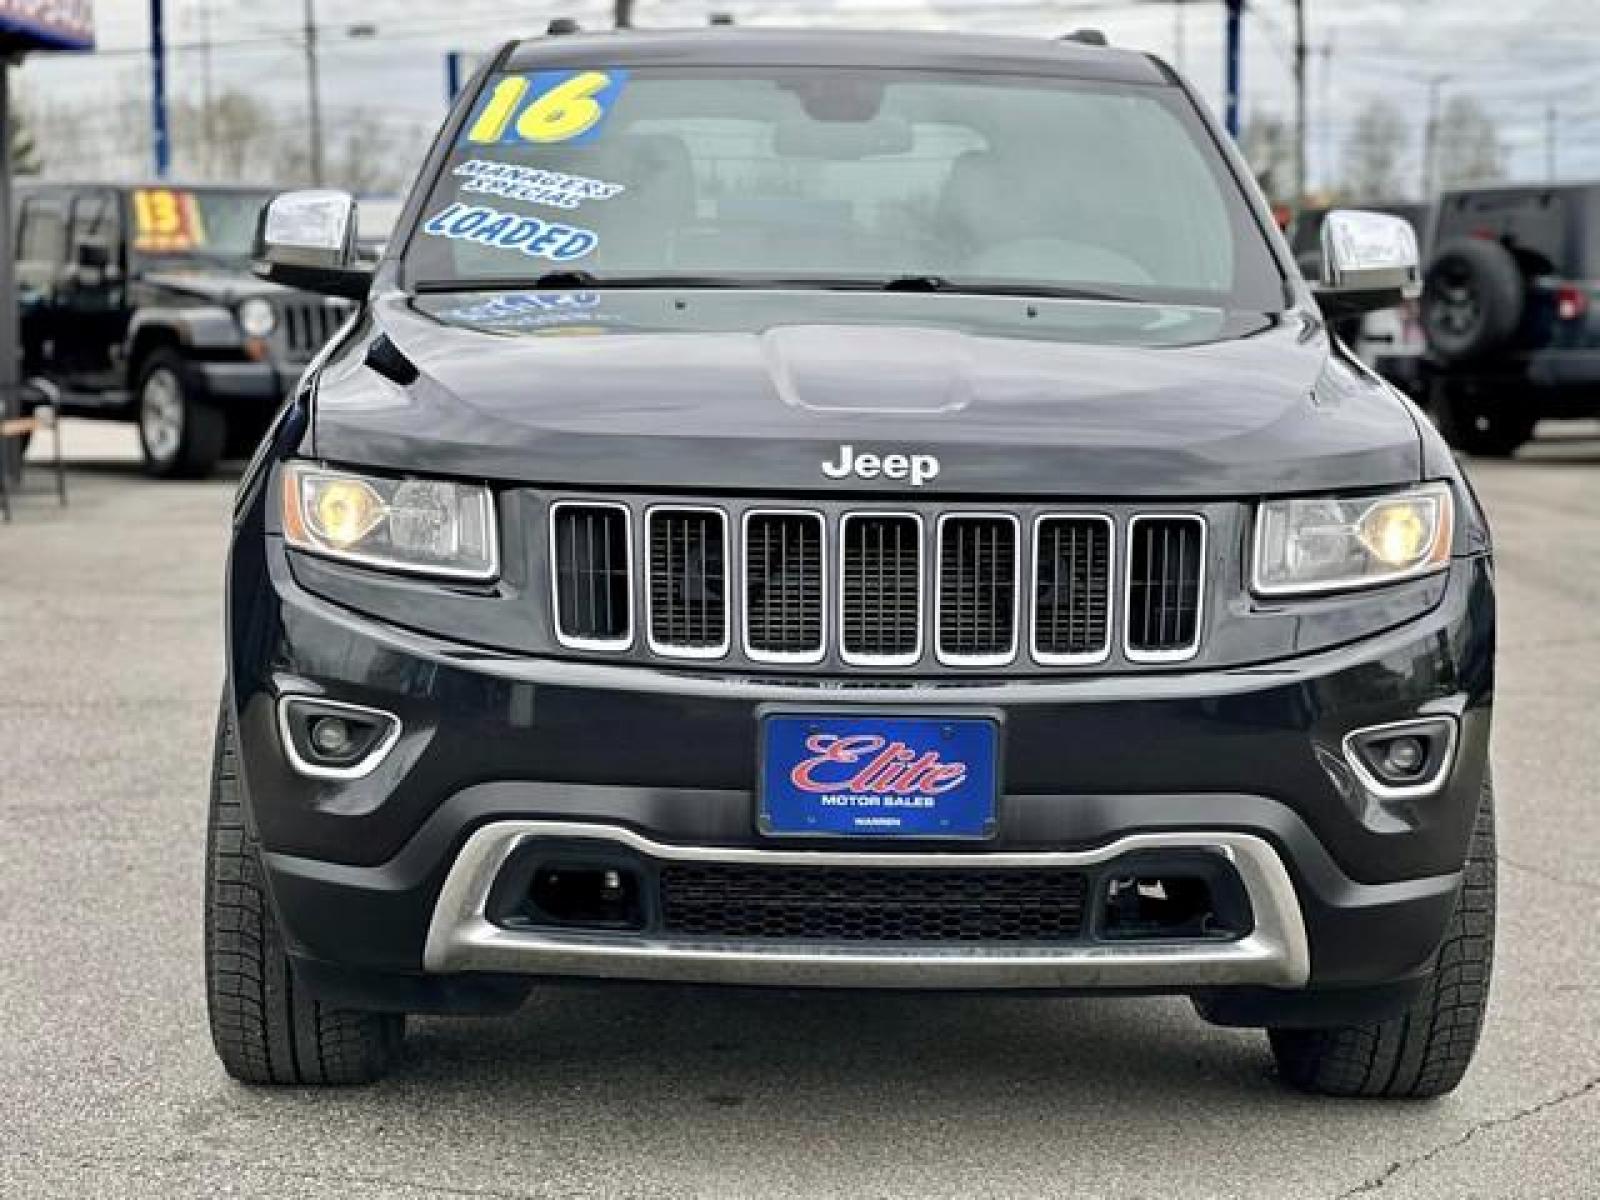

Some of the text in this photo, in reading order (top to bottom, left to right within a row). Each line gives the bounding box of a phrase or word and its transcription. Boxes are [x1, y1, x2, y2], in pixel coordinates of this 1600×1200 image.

[467, 72, 611, 143] 16
[425, 203, 599, 260] LOADED
[821, 444, 940, 486] Jeep
[790, 734, 967, 793] Elite
[821, 795, 936, 808] MOTOR SALES
